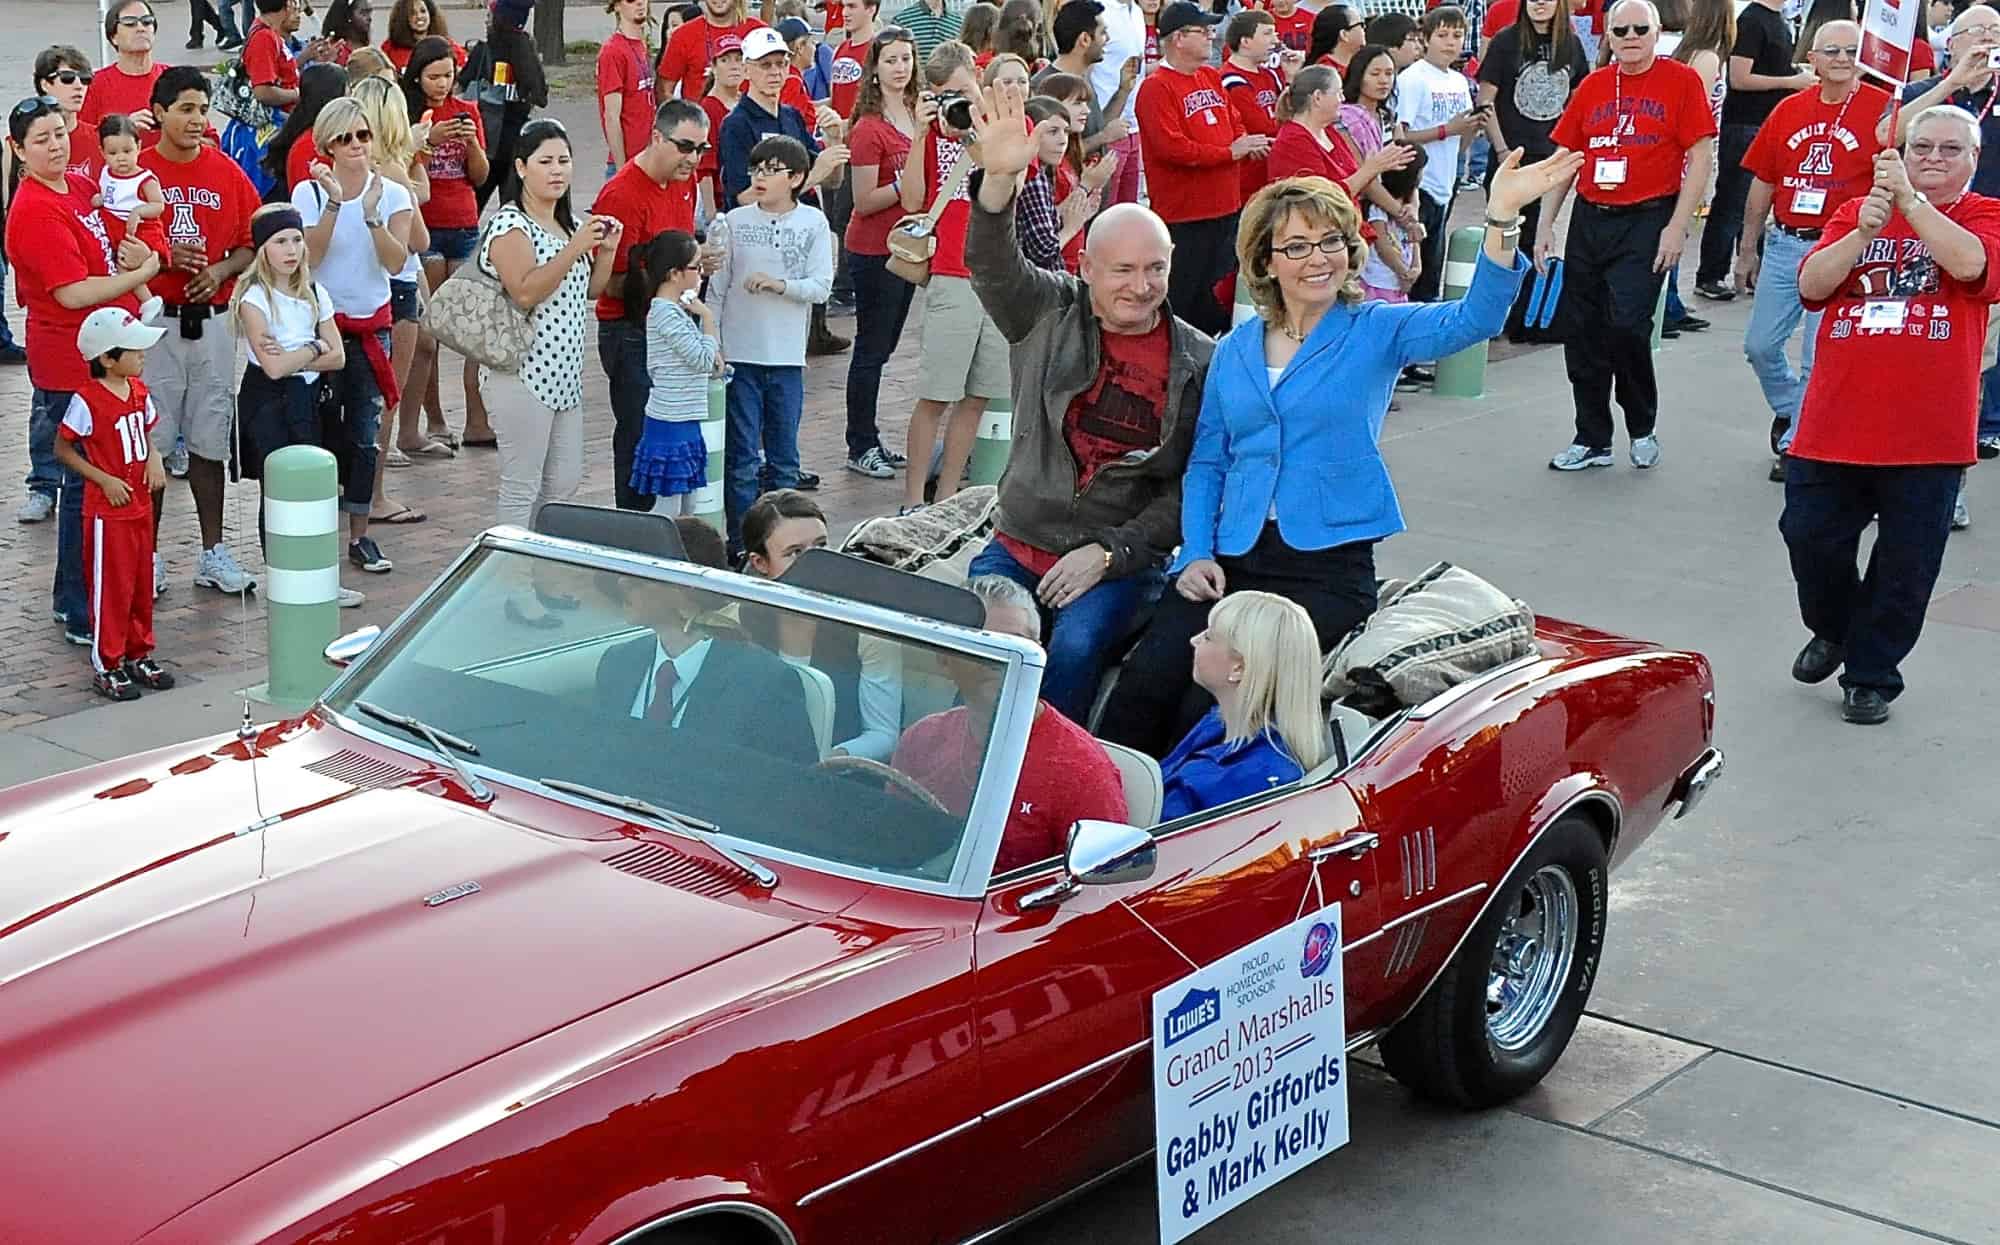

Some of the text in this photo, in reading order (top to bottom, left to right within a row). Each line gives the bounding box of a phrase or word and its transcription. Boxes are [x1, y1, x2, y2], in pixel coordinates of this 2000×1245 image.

[162, 187, 220, 210] VA LOS
[169, 204, 200, 236] A
[1830, 319, 1852, 339] 20
[1928, 319, 1950, 340] 13
[115, 410, 148, 464] 10
[1226, 958, 1286, 998] HOMECOMING
[1241, 951, 1270, 975] PROUD
[1236, 979, 1276, 1008] SPONSOR
[1166, 980, 1335, 1088] Grand Marshalls
[1168, 998, 1216, 1041] LOWE'S
[1231, 1049, 1275, 1091] 2013
[1166, 1053, 1341, 1177] Gabby Giffords
[1182, 1109, 1331, 1218] & Mark Kelly
